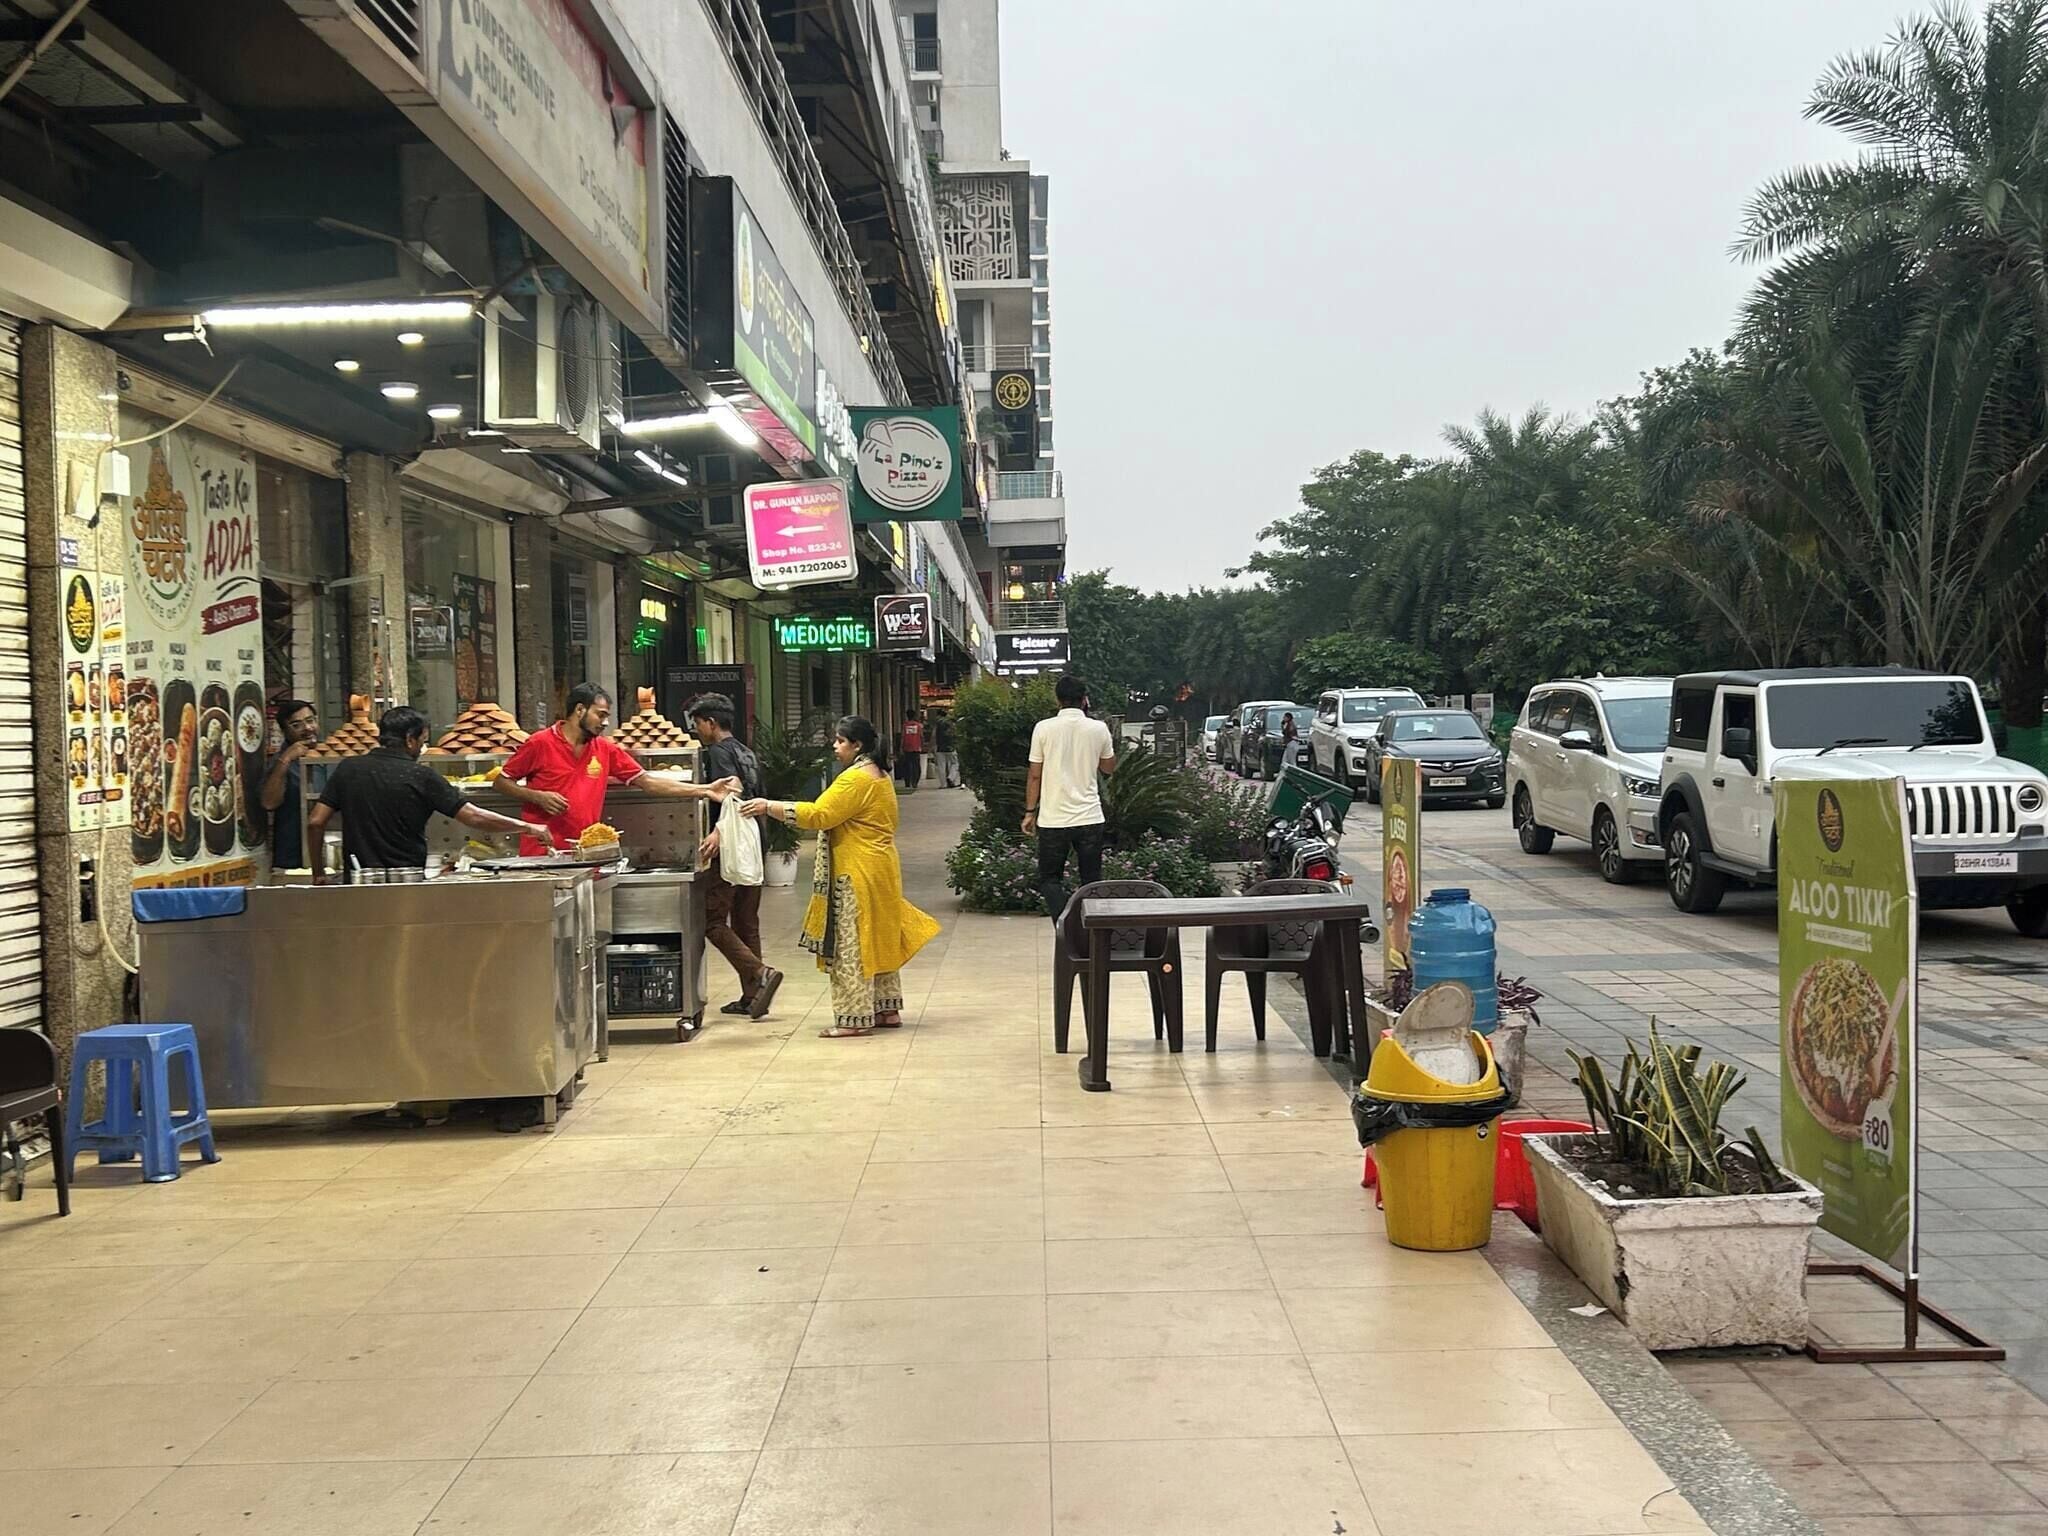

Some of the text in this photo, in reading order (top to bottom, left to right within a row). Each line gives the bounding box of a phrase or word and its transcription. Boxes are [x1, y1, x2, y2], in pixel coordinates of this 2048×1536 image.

[874, 449, 944, 470] La Pino'z
[888, 469, 927, 484] Pizza
[200, 467, 250, 517] Taste Ka
[752, 493, 840, 510] DR. GUNJAN KAPOOR
[204, 514, 253, 581] ADDA
[761, 548, 788, 558] Shop
[788, 545, 806, 555] No.
[762, 560, 848, 577] M: 9412202063
[780, 624, 865, 646] MEDICINE
[1011, 637, 1060, 650] Epicure
[1389, 817, 1407, 844] LASSI
[1788, 878, 1892, 929] ALOO TIKKI
[1866, 1115, 1890, 1151] ₹80
